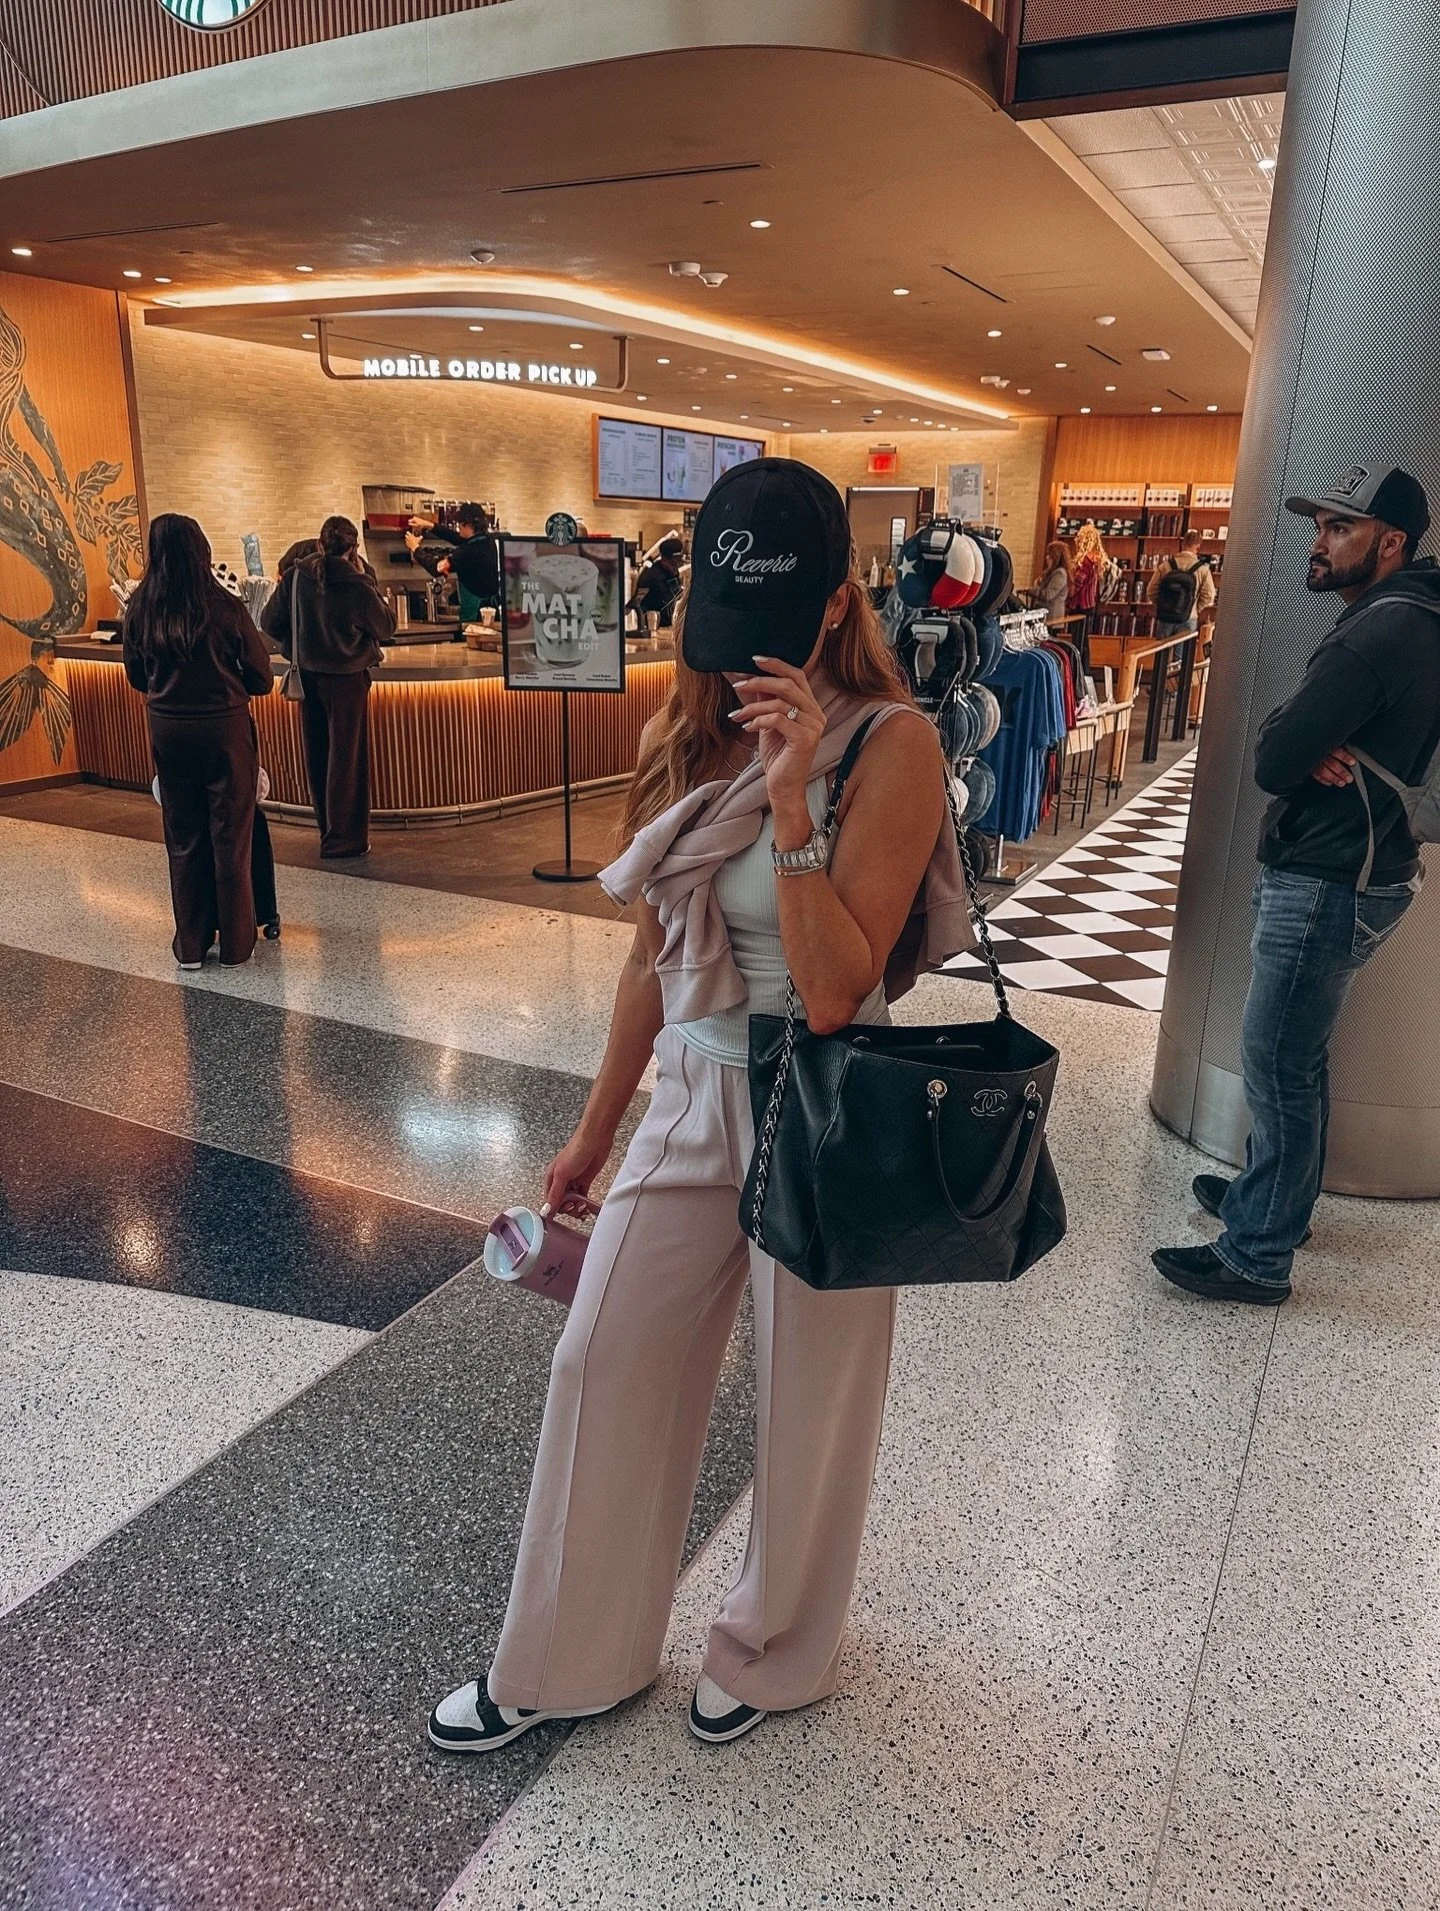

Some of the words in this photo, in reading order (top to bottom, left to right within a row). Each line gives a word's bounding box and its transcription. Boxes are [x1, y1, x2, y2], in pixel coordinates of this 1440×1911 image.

[363, 359, 440, 378] MOBILE
[448, 360, 521, 380] ORDER
[710, 528, 798, 573] Reverie
[521, 581, 540, 591] THE
[735, 575, 764, 584] BEAUTY
[521, 593, 582, 615] MAT
[543, 617, 600, 640] CHA
[578, 642, 600, 651] EDIT
